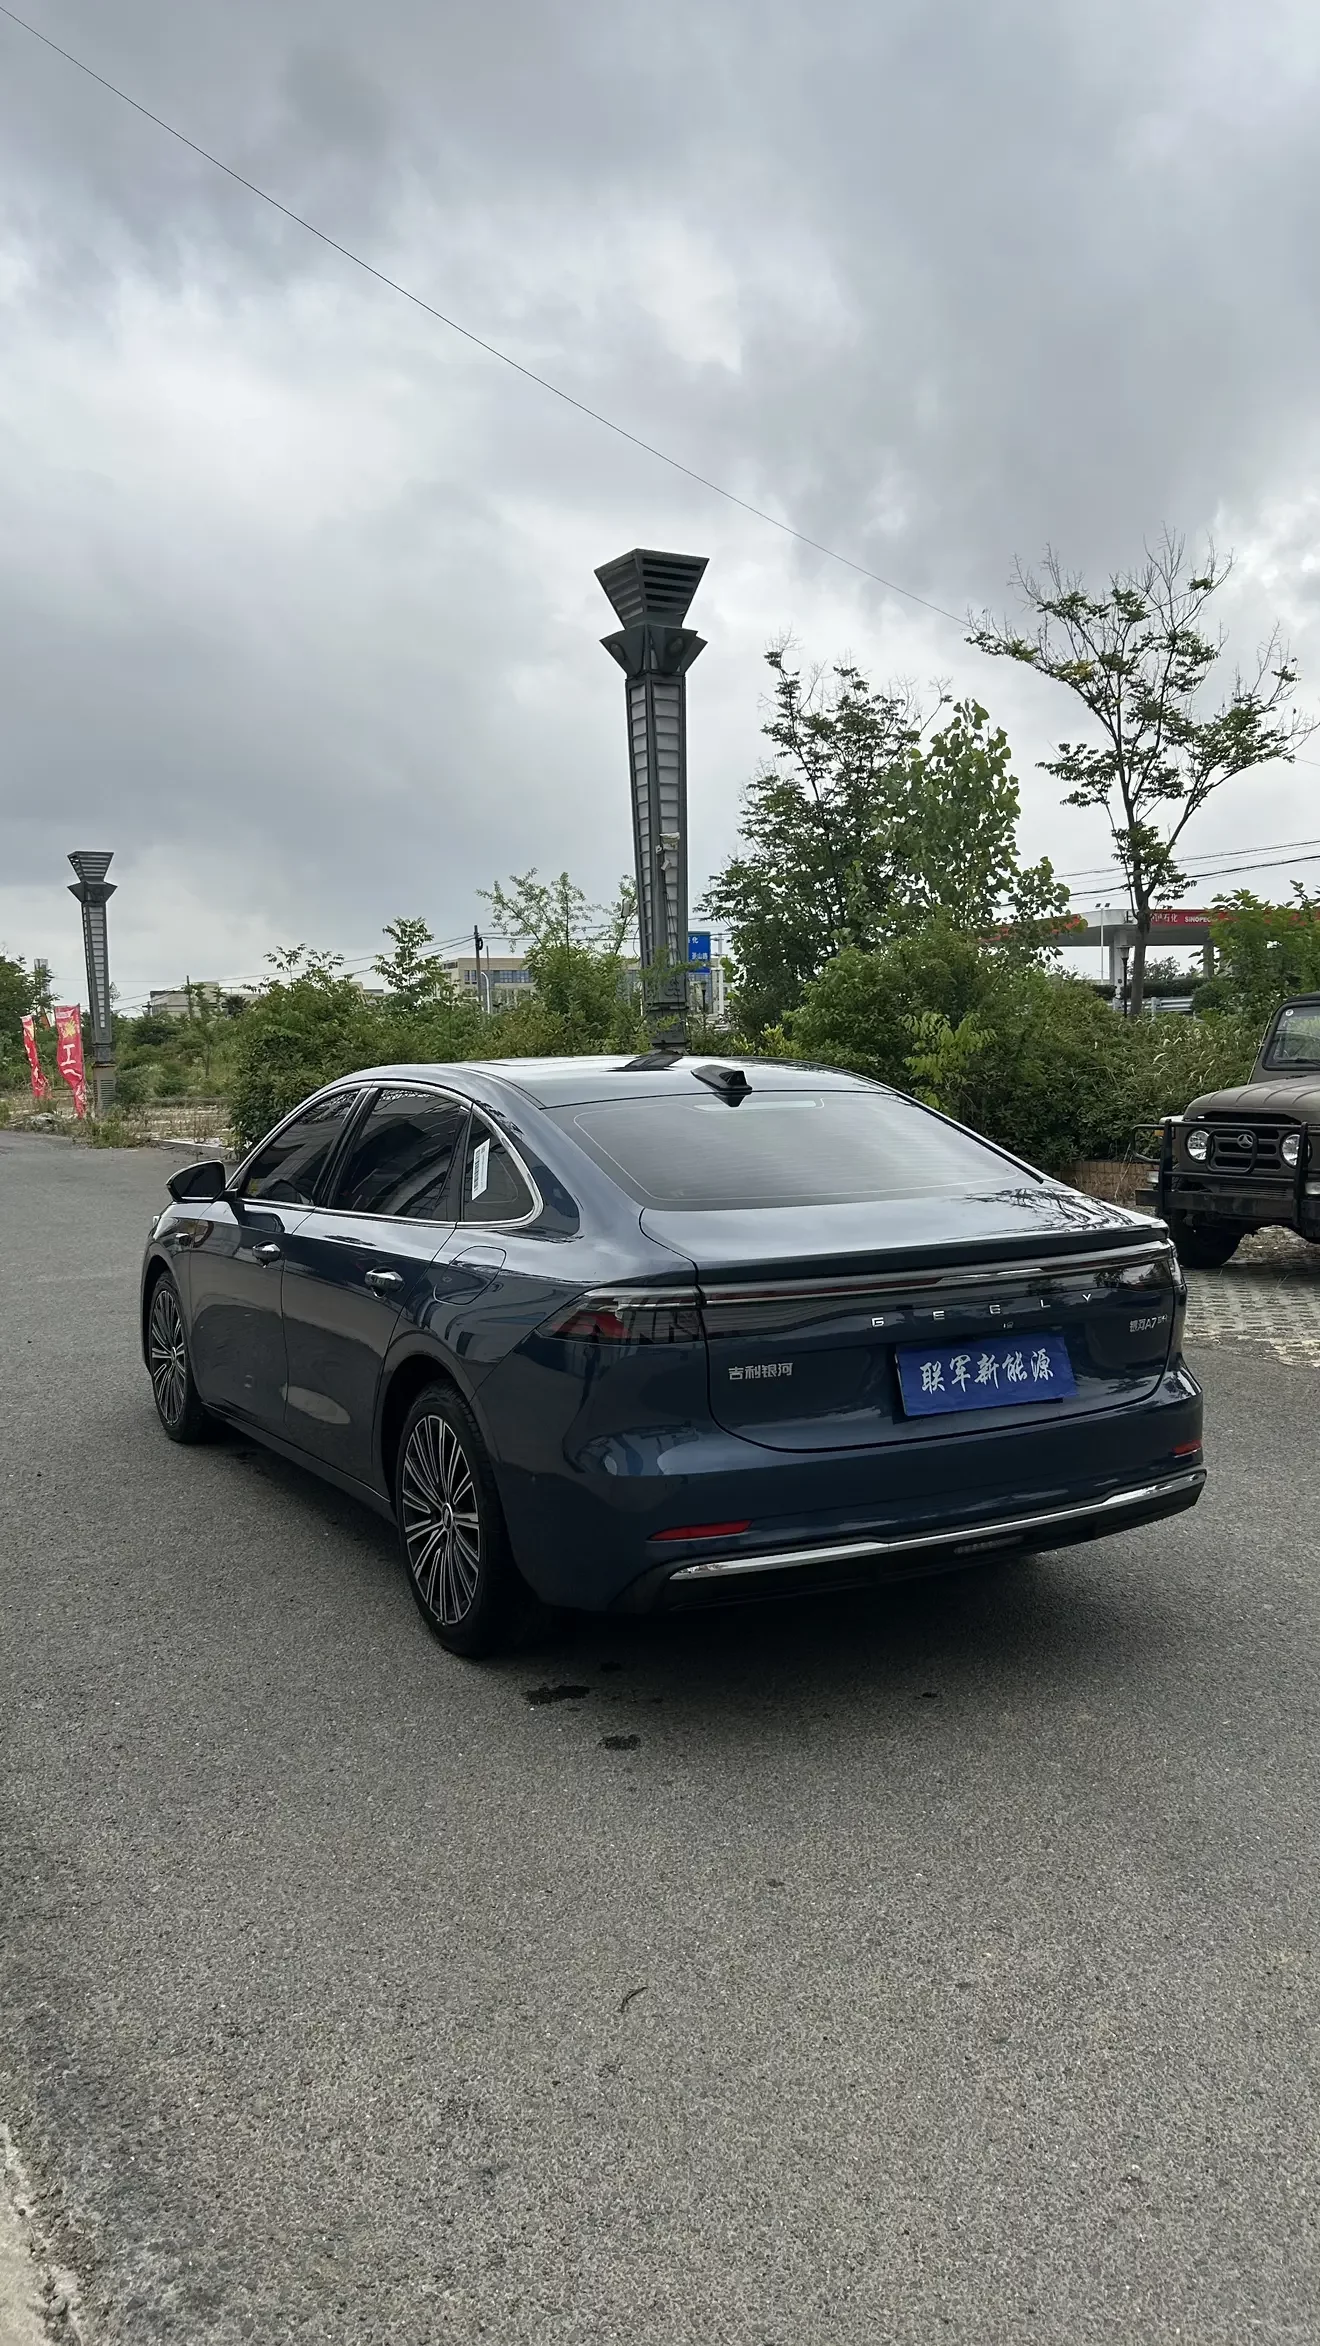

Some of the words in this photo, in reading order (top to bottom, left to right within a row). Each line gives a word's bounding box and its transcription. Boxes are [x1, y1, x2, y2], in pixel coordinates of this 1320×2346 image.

[871, 1293, 1092, 1327] GEELY
[728, 1362, 794, 1380] 吉利银河
[919, 1347, 1054, 1395] 联军新能源
